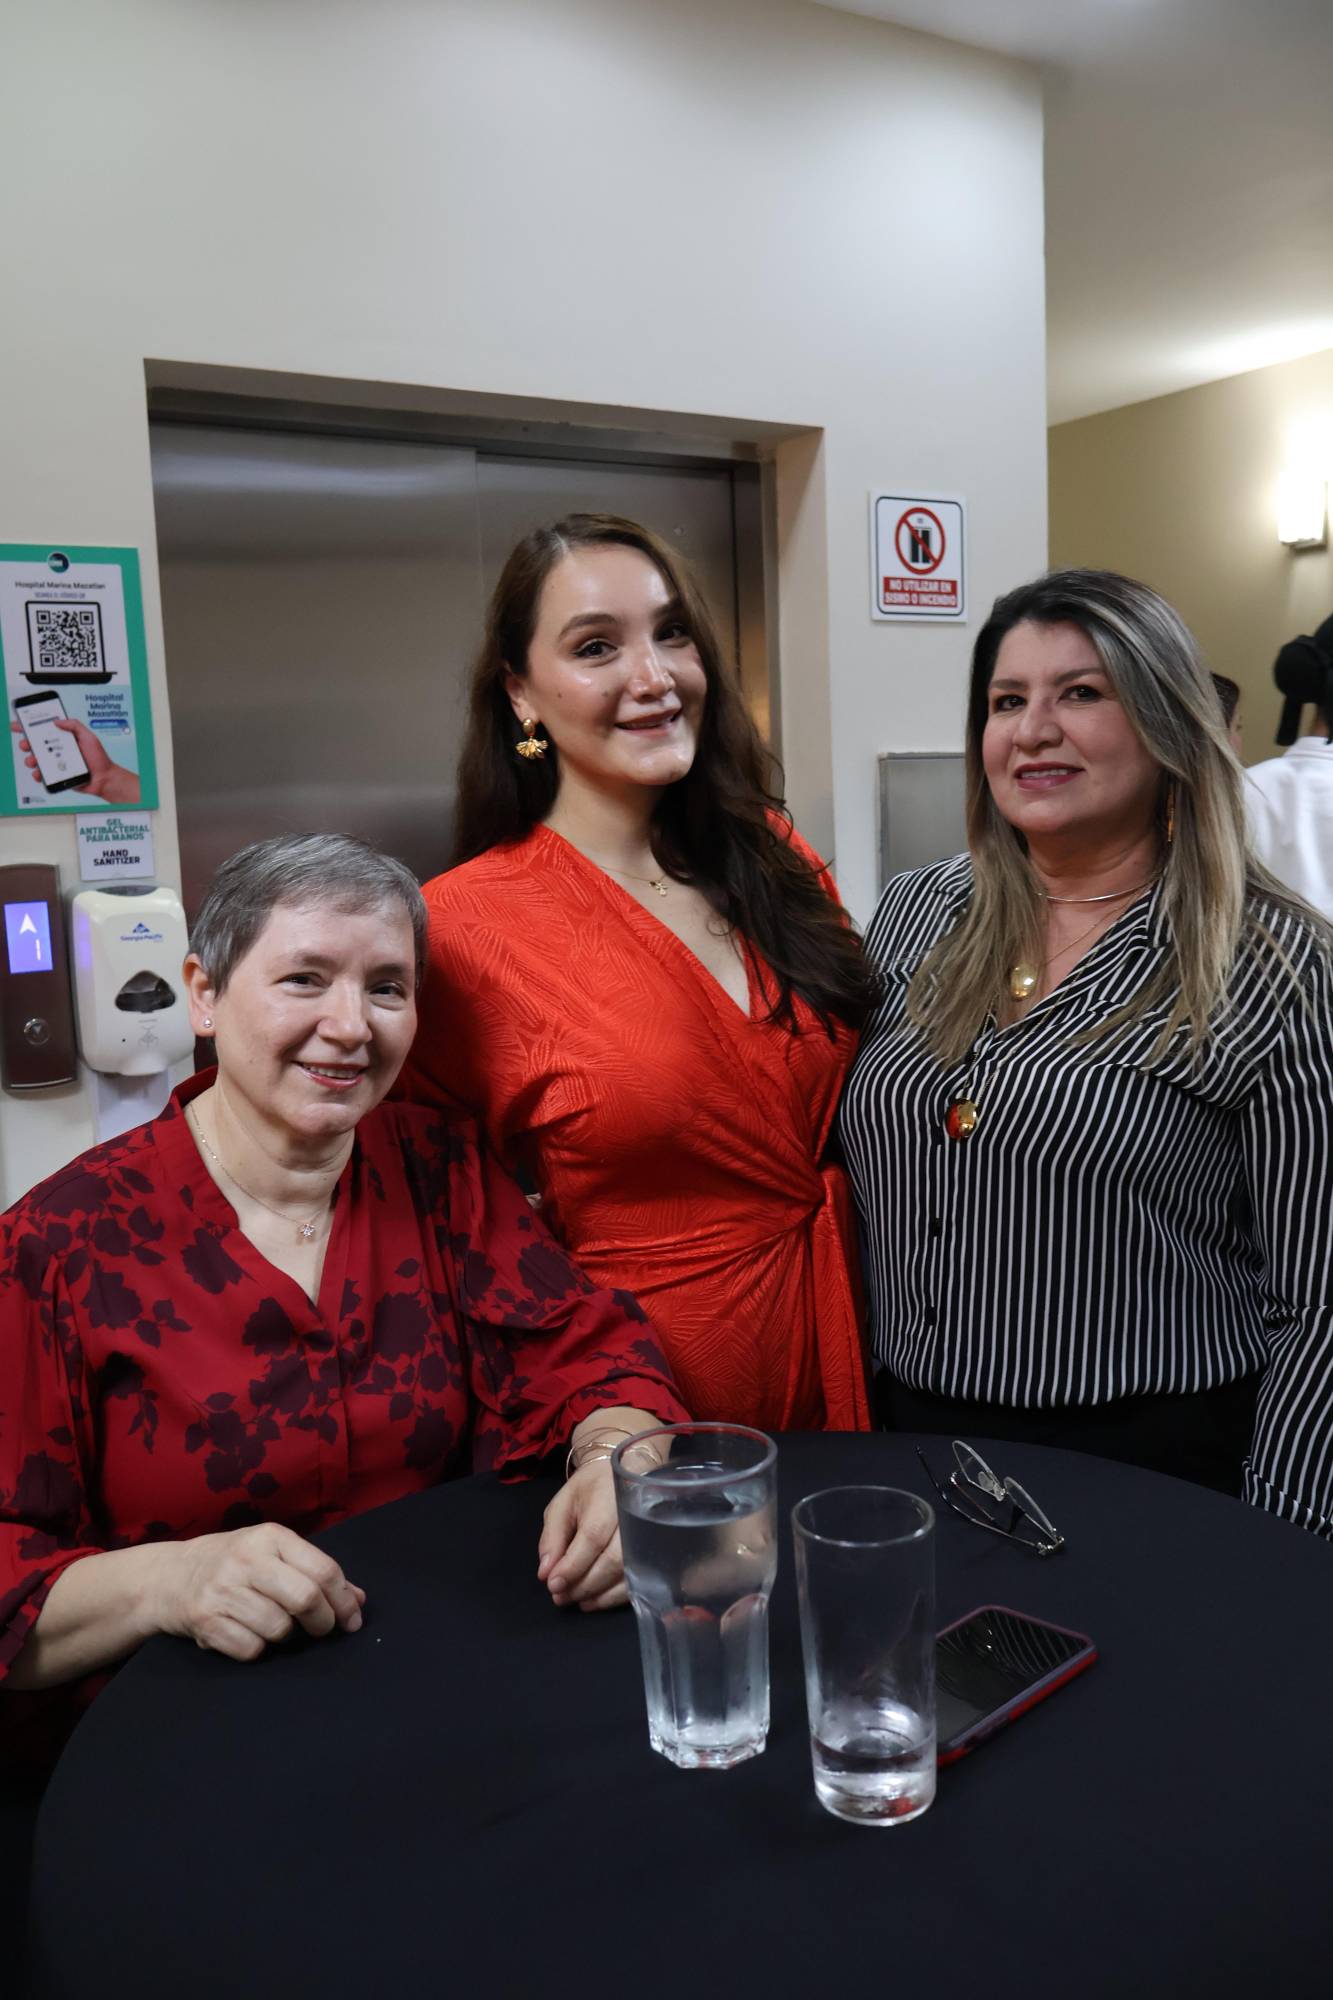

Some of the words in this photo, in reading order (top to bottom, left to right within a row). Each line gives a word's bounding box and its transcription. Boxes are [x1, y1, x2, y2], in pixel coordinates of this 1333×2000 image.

[15, 581, 45, 590] Hospital
[889, 579, 902, 590] NO
[85, 693, 124, 703] Hospital
[106, 818, 122, 827] GEL
[80, 824, 150, 835] ANTIBACTERIAL
[86, 834, 110, 842] PARA
[112, 832, 144, 841] MANOS
[102, 849, 128, 858] HAND
[93, 856, 140, 866] SANITIZER
